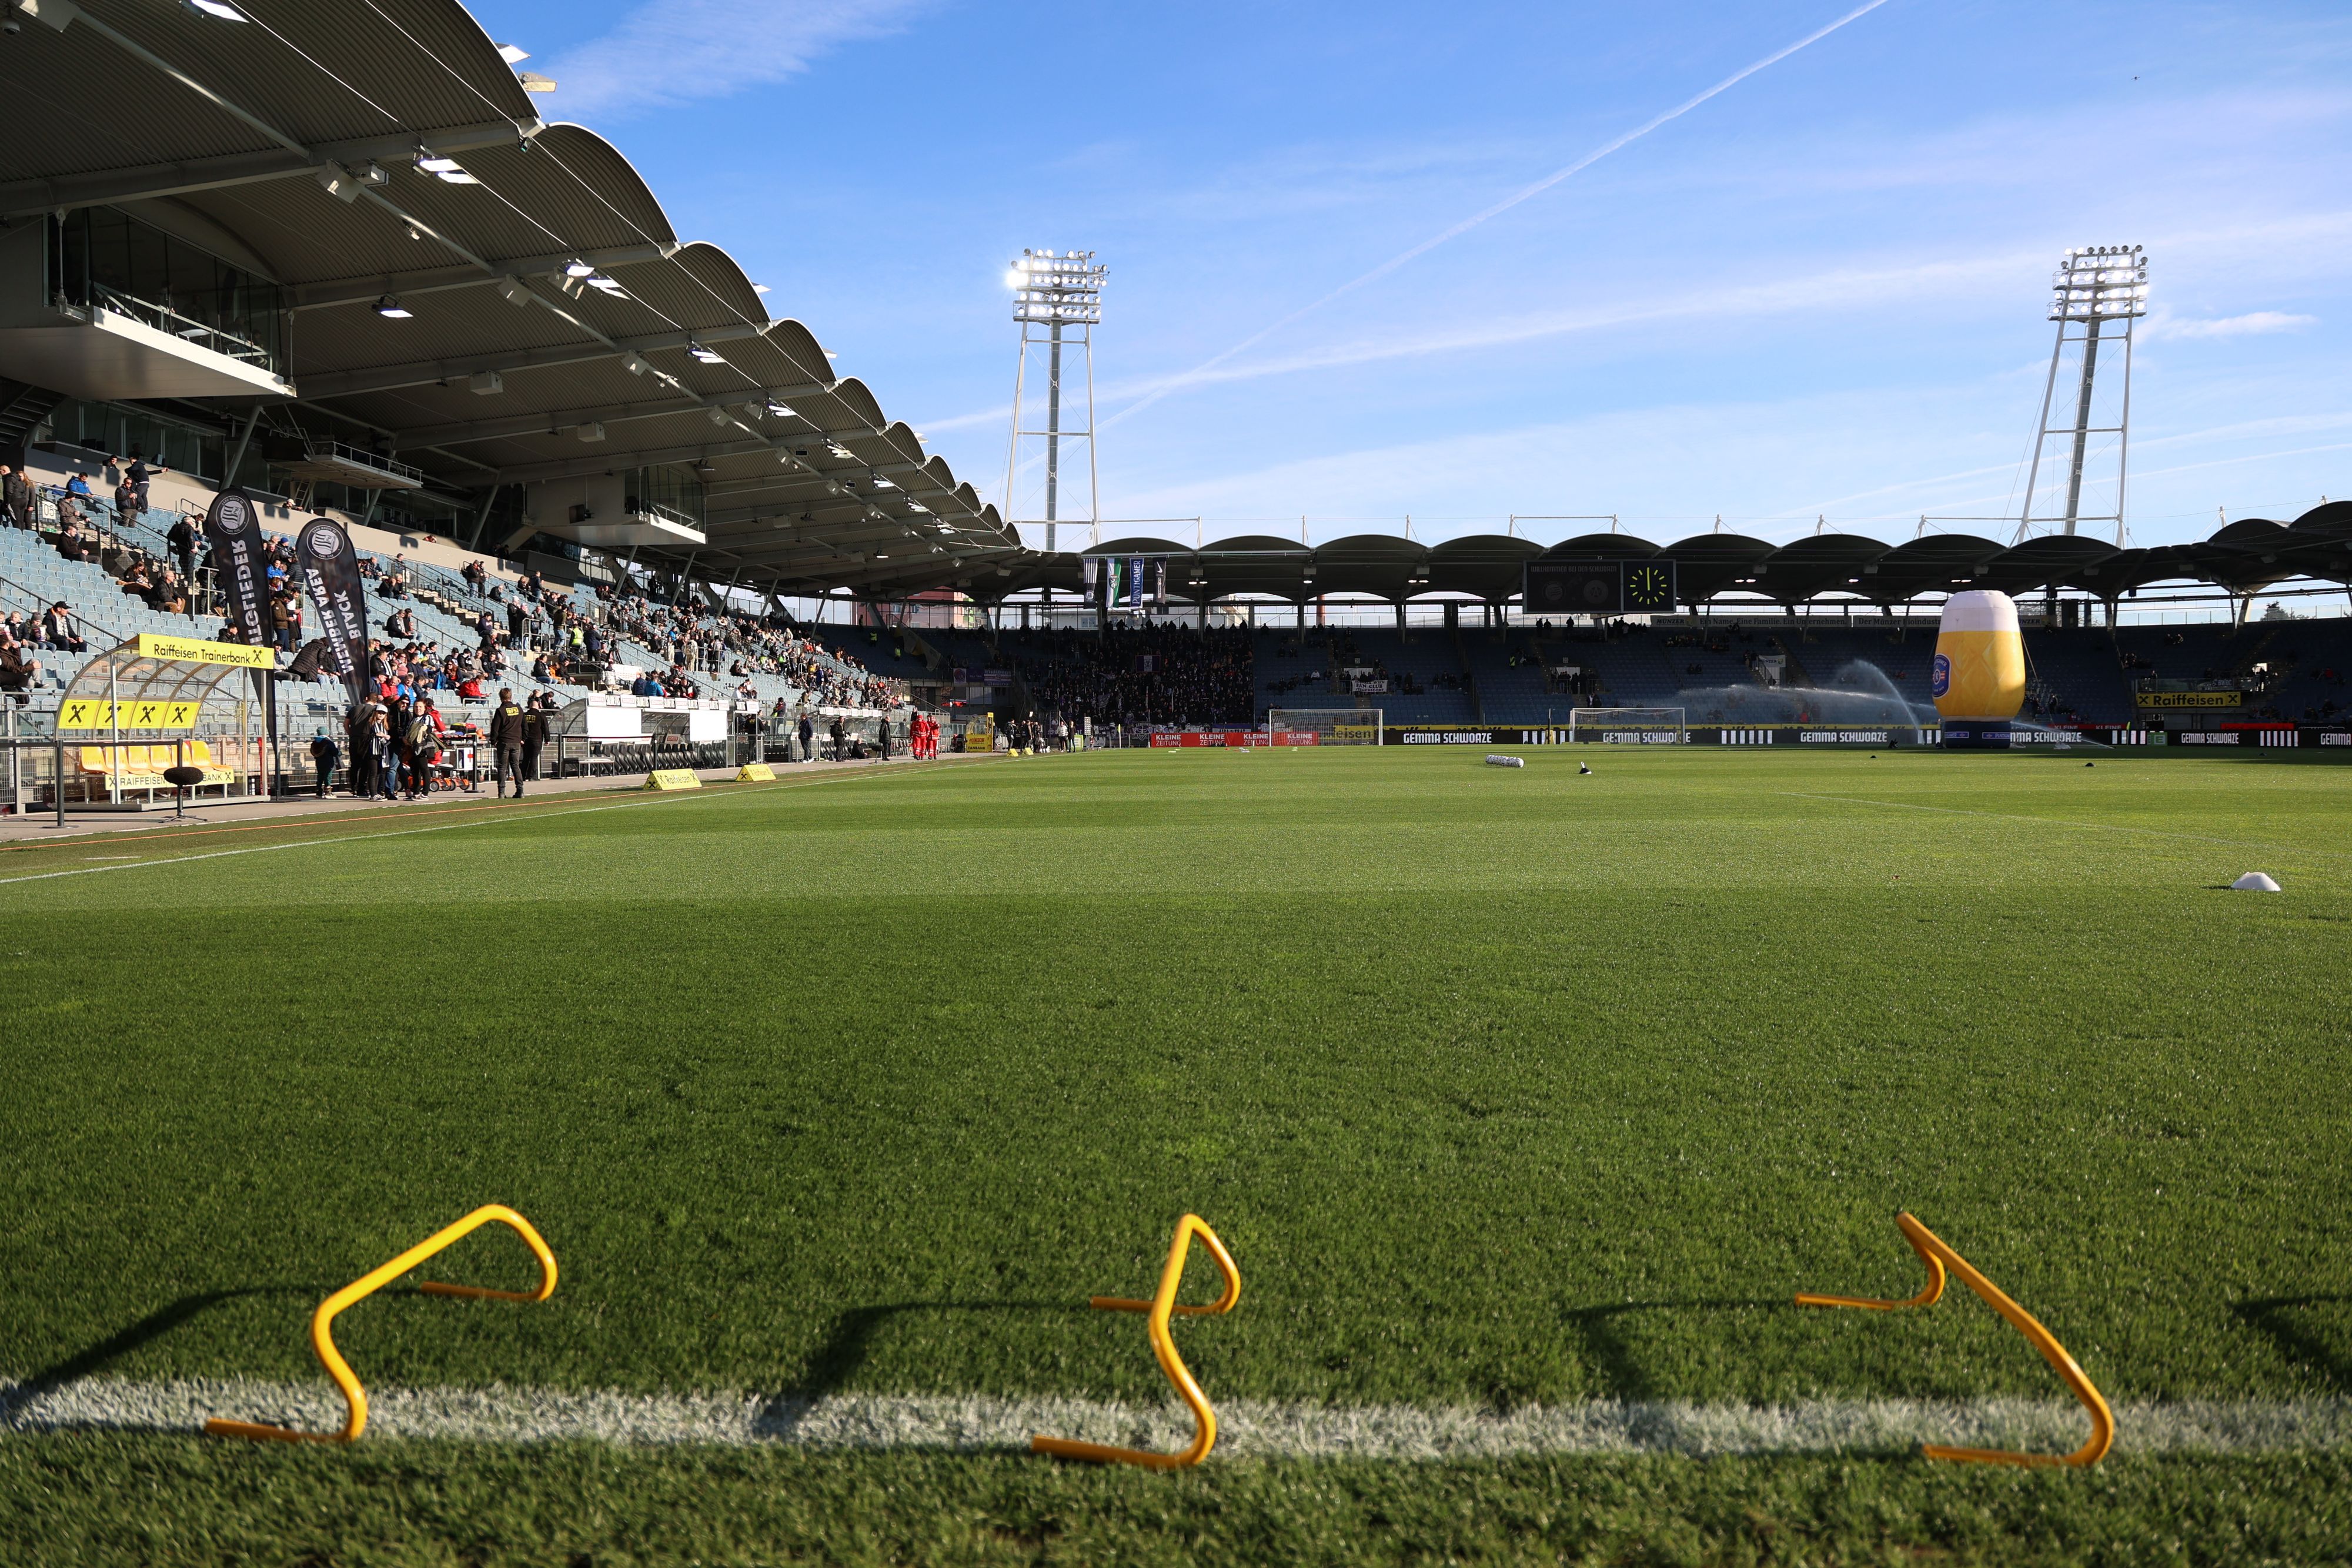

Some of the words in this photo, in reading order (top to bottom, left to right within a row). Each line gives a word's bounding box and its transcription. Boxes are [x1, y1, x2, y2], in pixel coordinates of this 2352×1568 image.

[44, 504, 54, 516] 05
[1132, 560, 1141, 604] PUNTIGAMER
[154, 644, 197, 659] Raiffeisen
[201, 648, 250, 664] Trainerbank
[2153, 694, 2223, 706] Raiffeisen
[1404, 733, 1441, 743] GEMMA
[1443, 733, 1492, 743] SCHWOAZE
[1603, 733, 1639, 743] GEMMA
[1642, 732, 1690, 743] SCHWOE
[1800, 732, 1837, 742] GEMMA
[1839, 732, 1887, 742] SCHWOAZE
[2034, 732, 2082, 743] SCHWOAZE
[2181, 733, 2205, 744] GEMMA
[2206, 733, 2239, 744] SCHWOAZE
[2320, 733, 2351, 745] GEMMA
[120, 776, 165, 785] RAIFFEISEN
[665, 774, 690, 784] Raiffeisen
